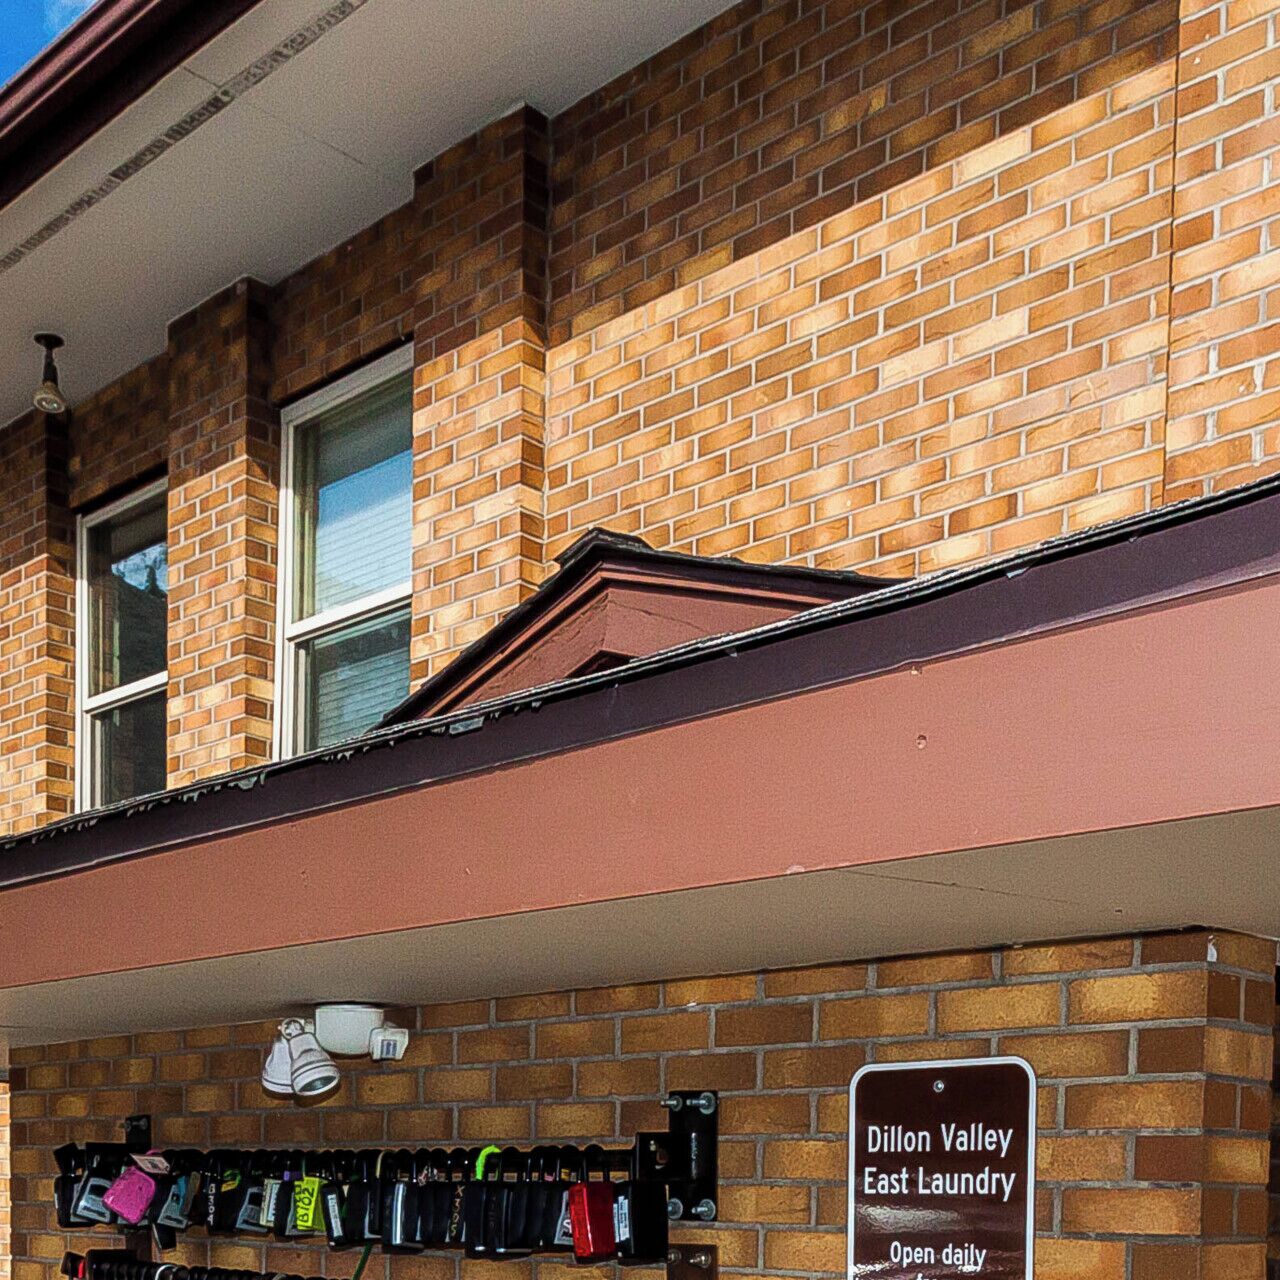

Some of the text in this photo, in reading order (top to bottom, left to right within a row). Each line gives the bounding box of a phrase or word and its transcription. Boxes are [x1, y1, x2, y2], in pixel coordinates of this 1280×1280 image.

[867, 1123, 1014, 1158] Dillon Valley
[863, 1166, 1016, 1202] East Laundry
[890, 1241, 987, 1272] Open daily
